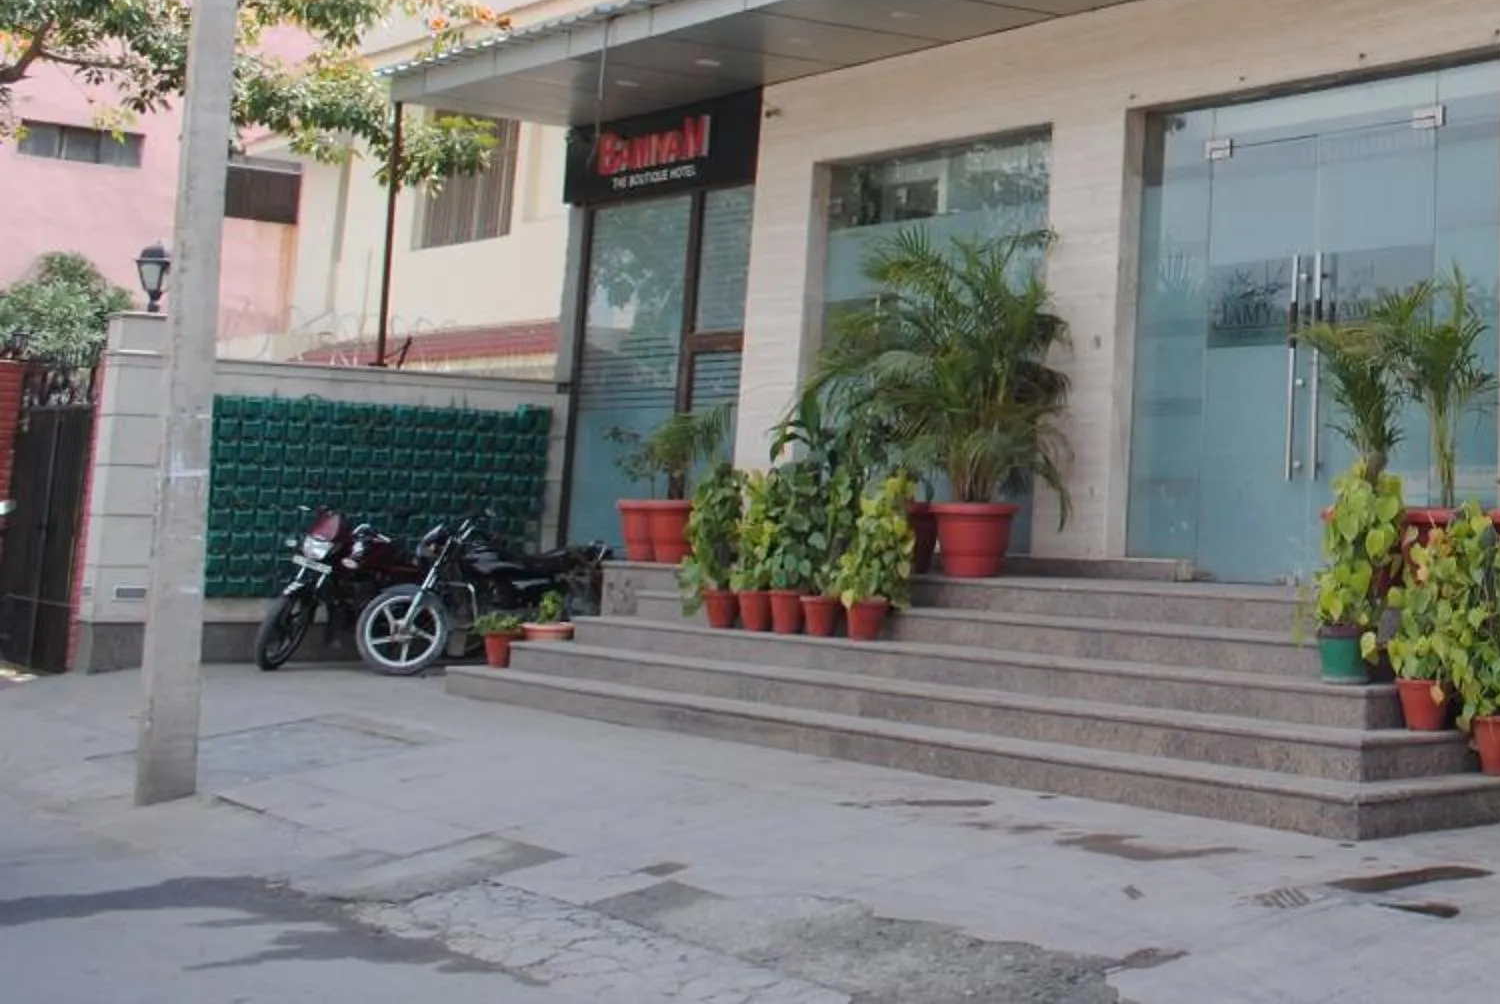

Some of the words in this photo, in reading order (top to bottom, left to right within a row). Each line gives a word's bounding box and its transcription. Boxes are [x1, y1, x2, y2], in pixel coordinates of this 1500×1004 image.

[612, 175, 628, 190] THE
[629, 169, 669, 187] BOUTIQUE
[670, 165, 696, 180] HOTEL
